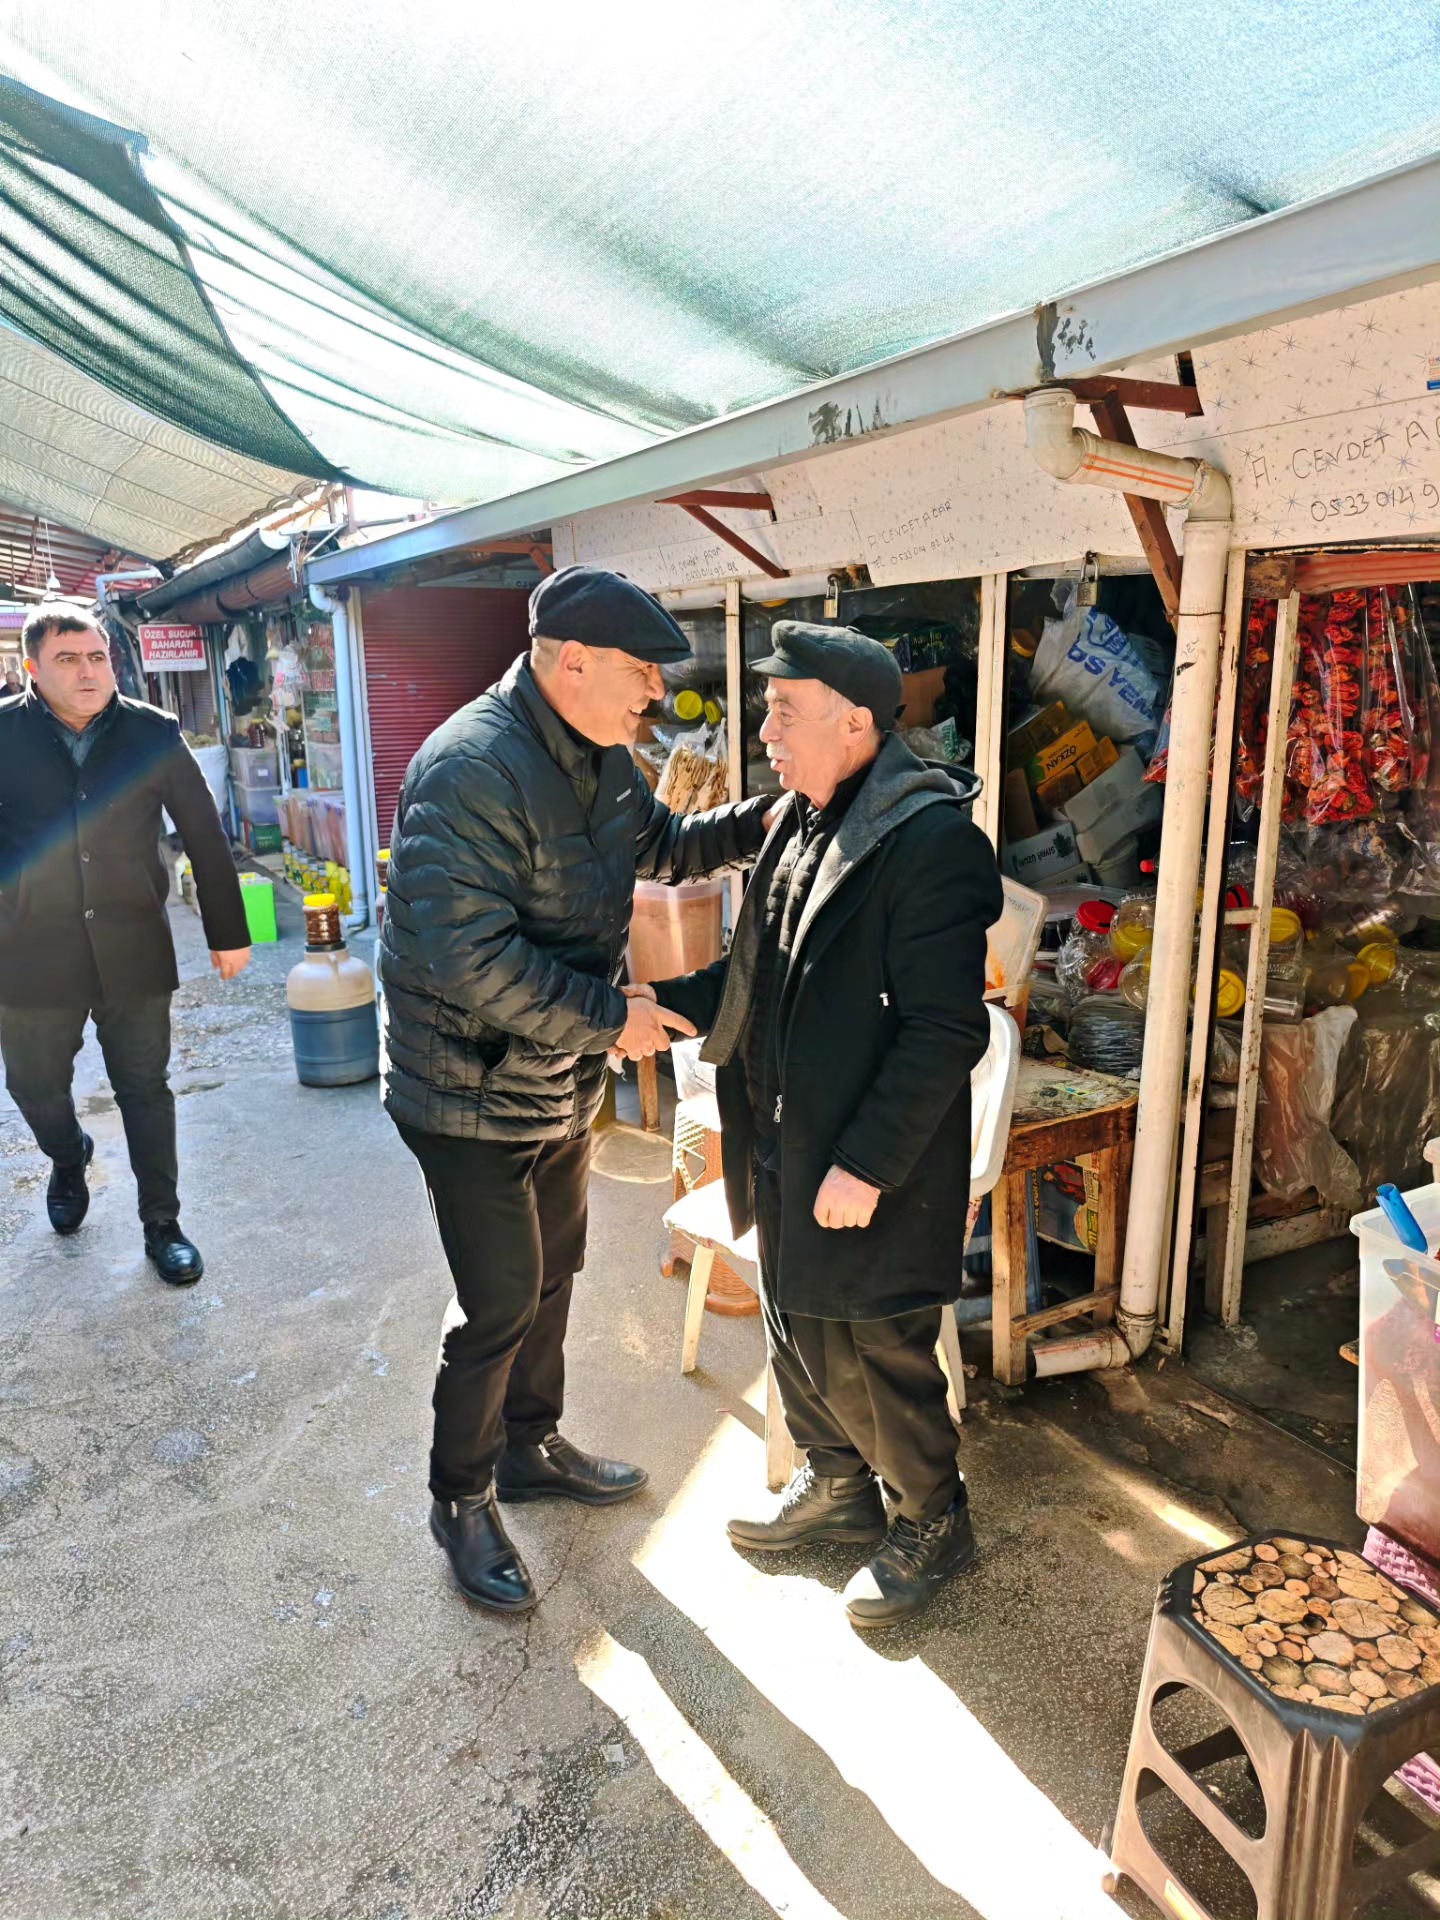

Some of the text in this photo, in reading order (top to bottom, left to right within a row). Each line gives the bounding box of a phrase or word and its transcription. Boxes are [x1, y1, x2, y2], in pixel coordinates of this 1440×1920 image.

[1291, 432, 1391, 480] CEVDET
[143, 628, 197, 640] ÖZEL SUCUK
[151, 639, 194, 650] BAHARATI
[148, 649, 199, 660] HAZIRLANIR
